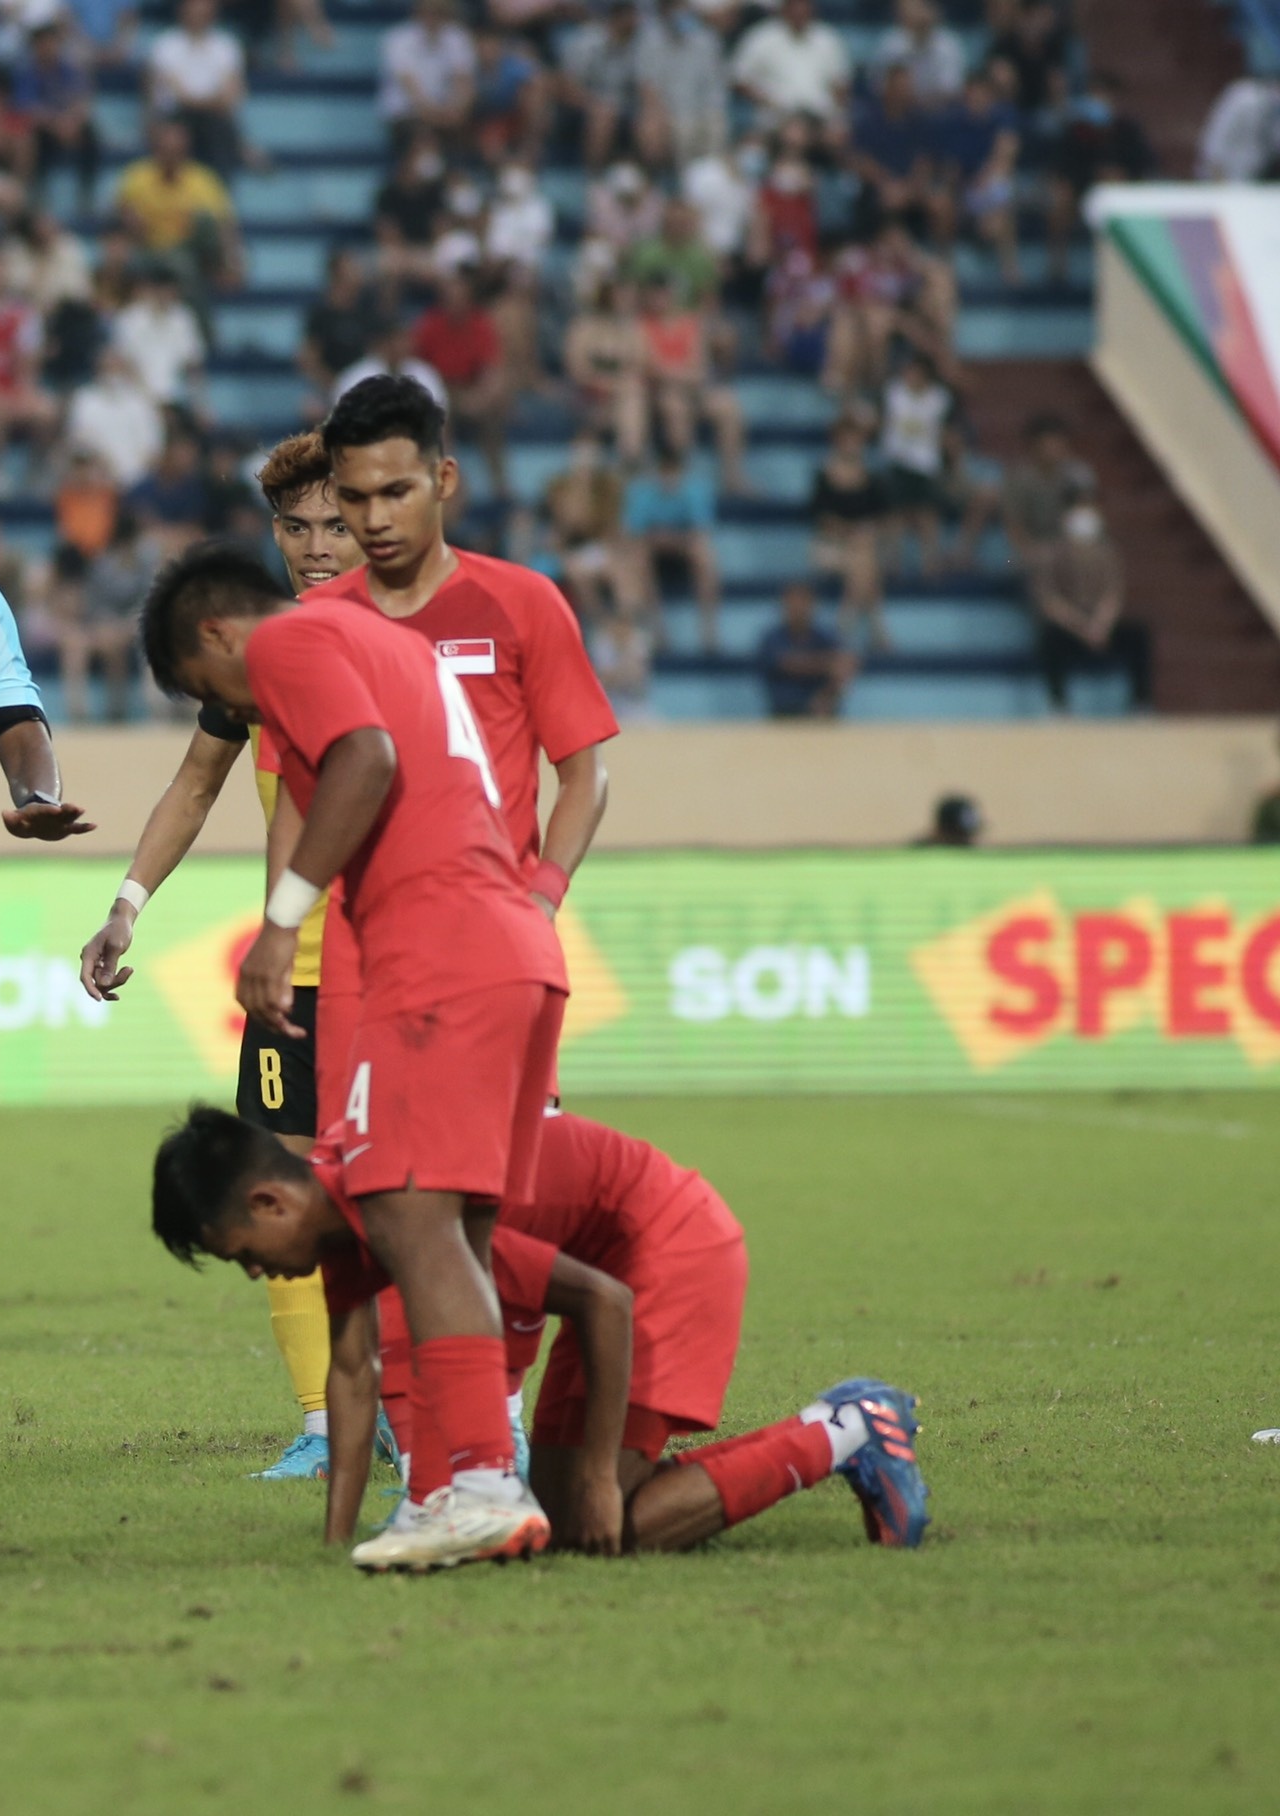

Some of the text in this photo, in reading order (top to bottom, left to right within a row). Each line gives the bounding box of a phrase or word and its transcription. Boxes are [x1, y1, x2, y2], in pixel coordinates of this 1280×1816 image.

[436, 655, 502, 809] 4
[259, 1048, 284, 1110] 8
[345, 1061, 372, 1135] 4
